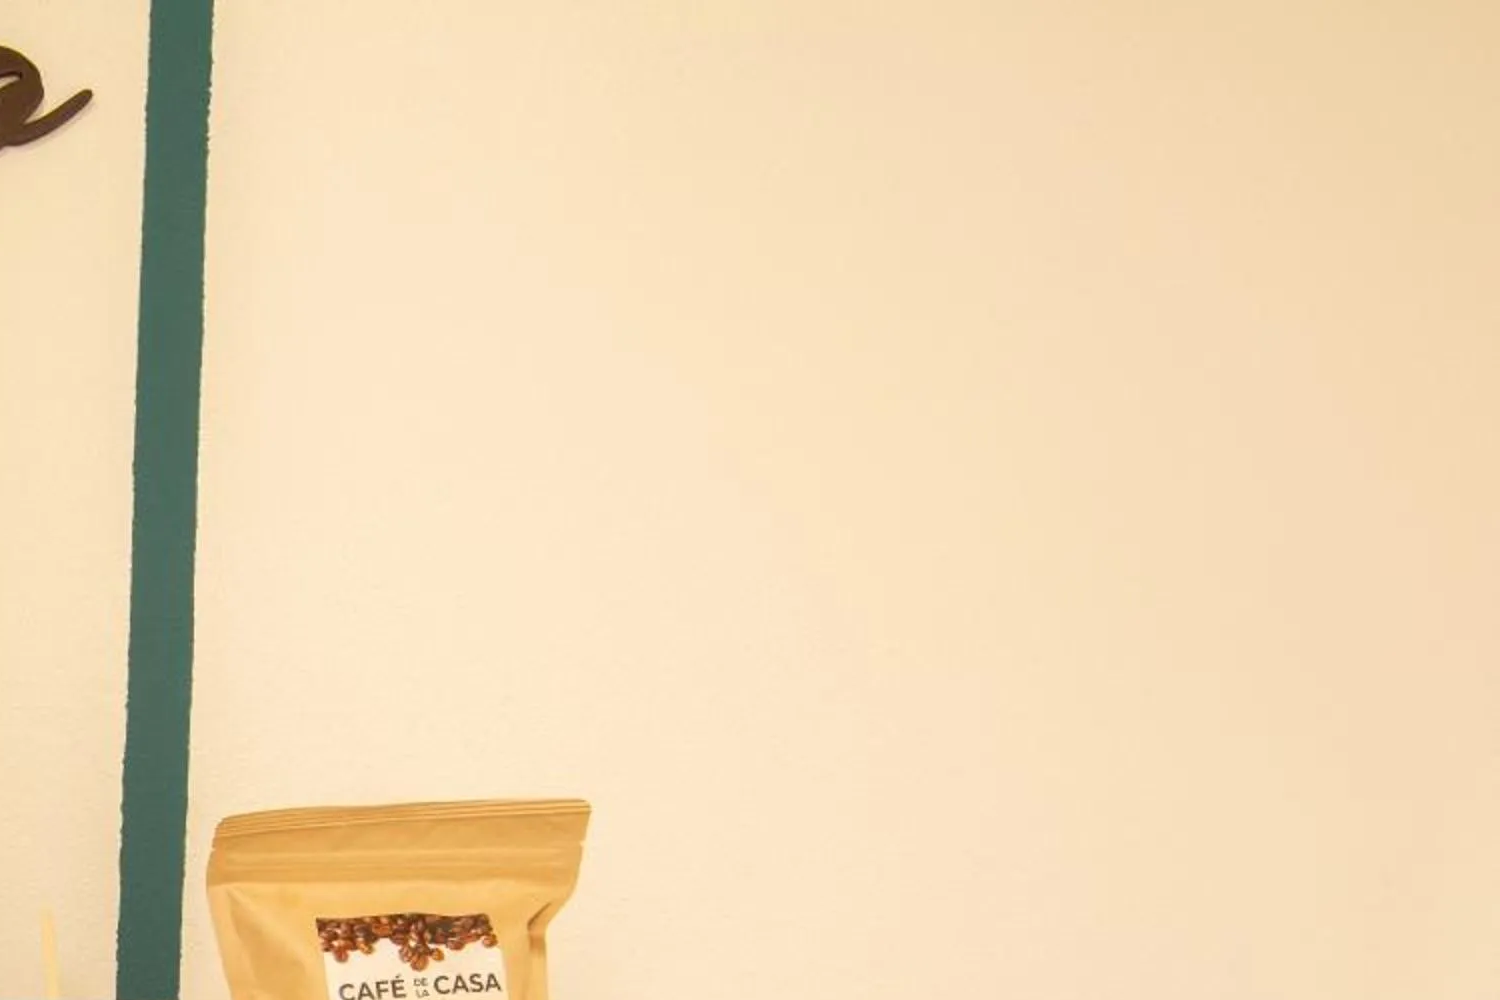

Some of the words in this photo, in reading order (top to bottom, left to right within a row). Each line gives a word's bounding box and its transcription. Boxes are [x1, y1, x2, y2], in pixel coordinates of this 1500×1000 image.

[413, 977, 429, 987] DE
[433, 972, 503, 995] CASA
[415, 989, 430, 999] LA
